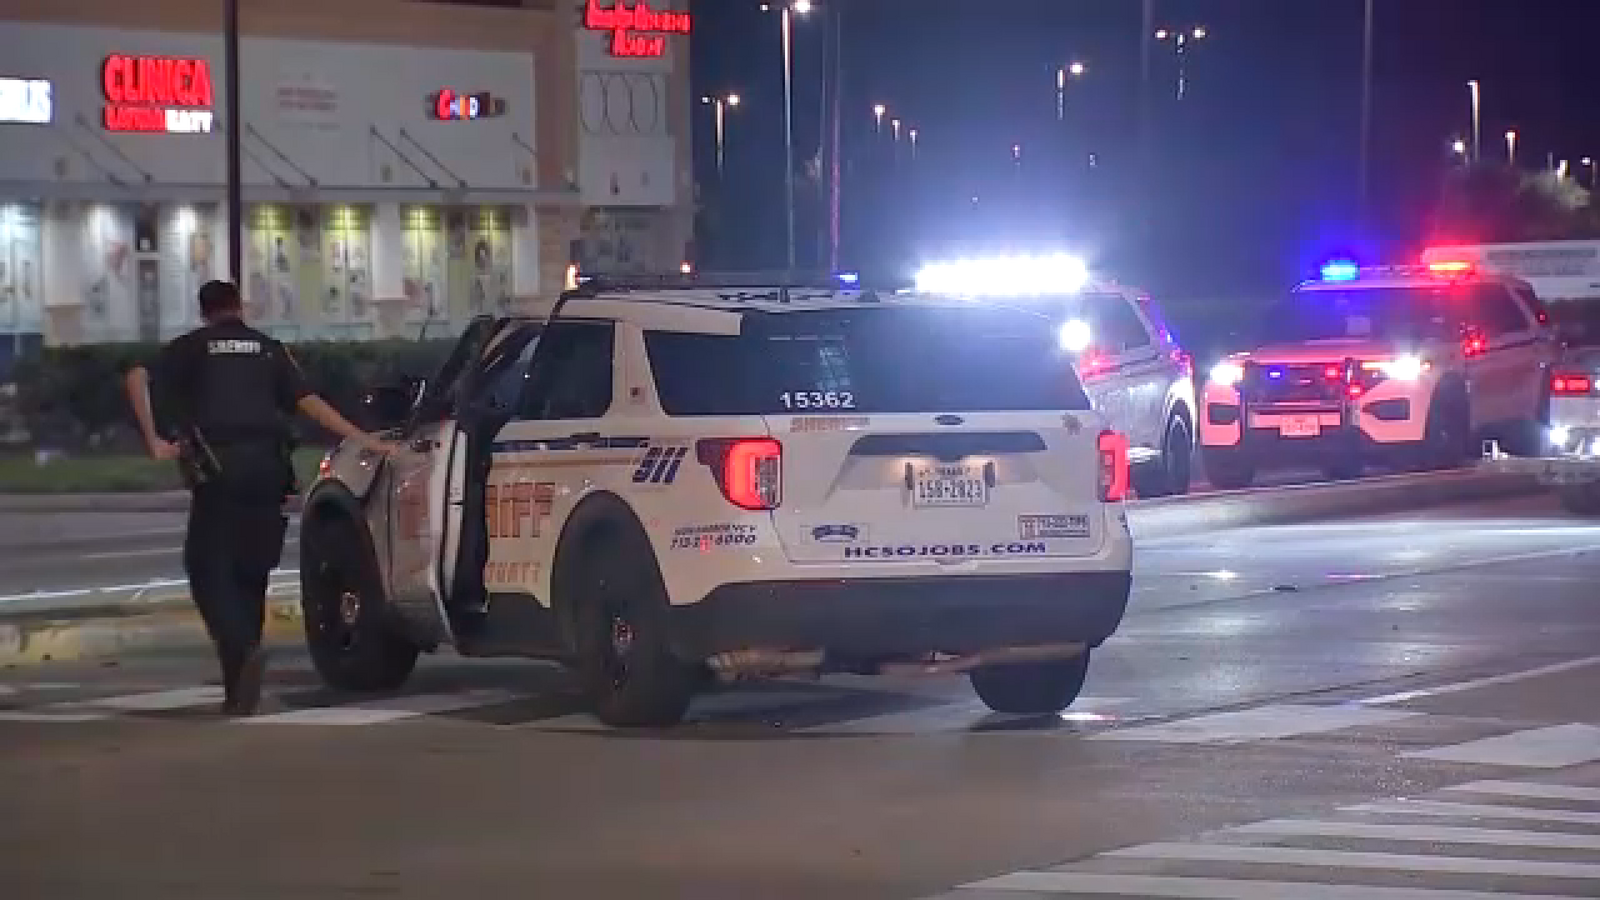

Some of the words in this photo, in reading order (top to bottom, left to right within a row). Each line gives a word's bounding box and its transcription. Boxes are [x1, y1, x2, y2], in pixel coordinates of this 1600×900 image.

[103, 54, 212, 107] CLINICA
[780, 391, 856, 409] 15362
[844, 541, 1047, 558] HCSOJOBS.COM
